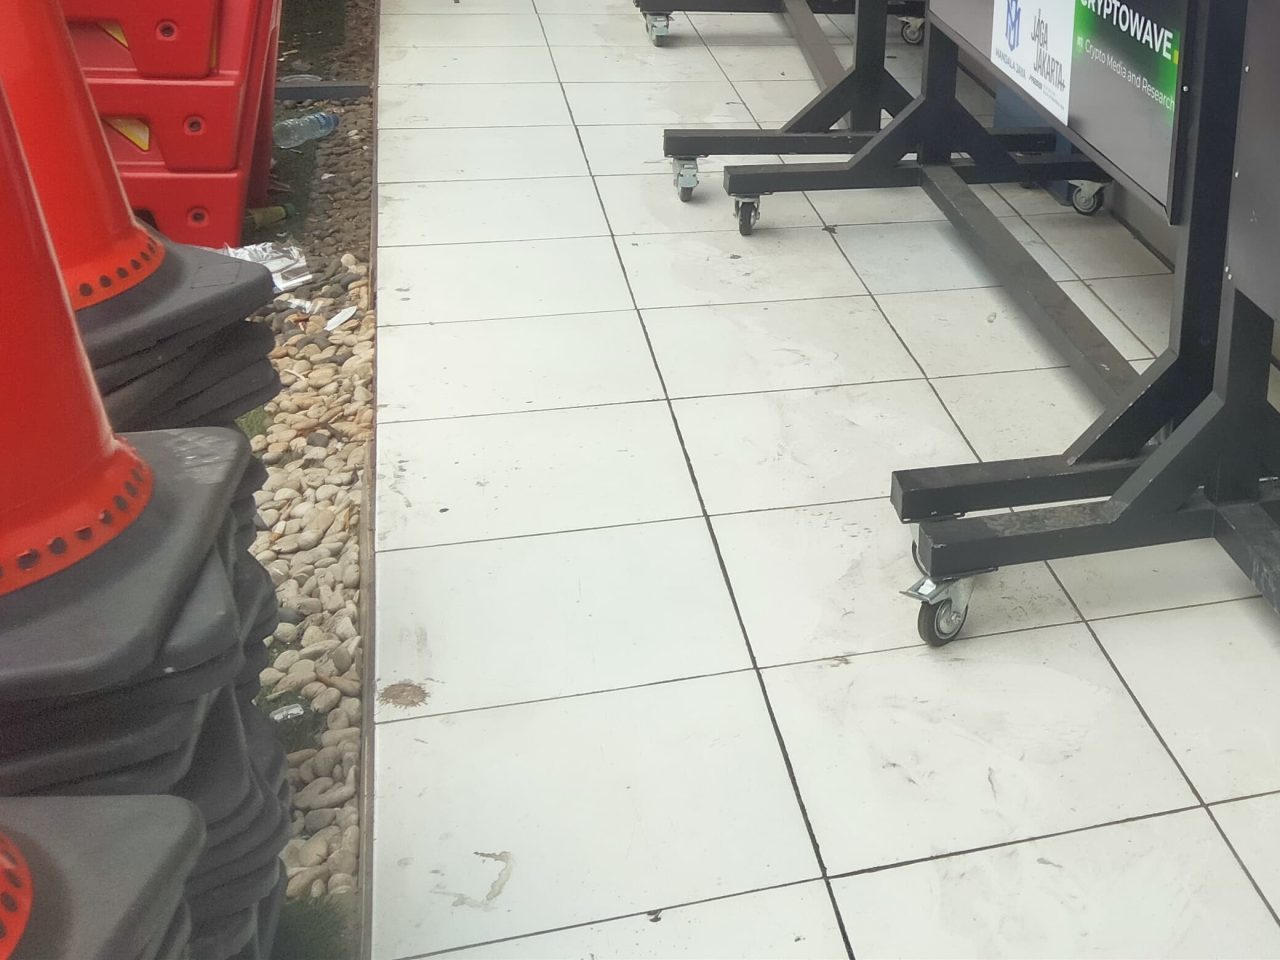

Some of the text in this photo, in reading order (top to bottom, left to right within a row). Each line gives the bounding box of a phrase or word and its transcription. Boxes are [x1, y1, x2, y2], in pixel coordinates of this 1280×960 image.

[1085, 38, 1106, 64] Crypto
[1106, 54, 1127, 79] Media
[1127, 72, 1141, 88] and
[1142, 78, 1176, 113] Research
